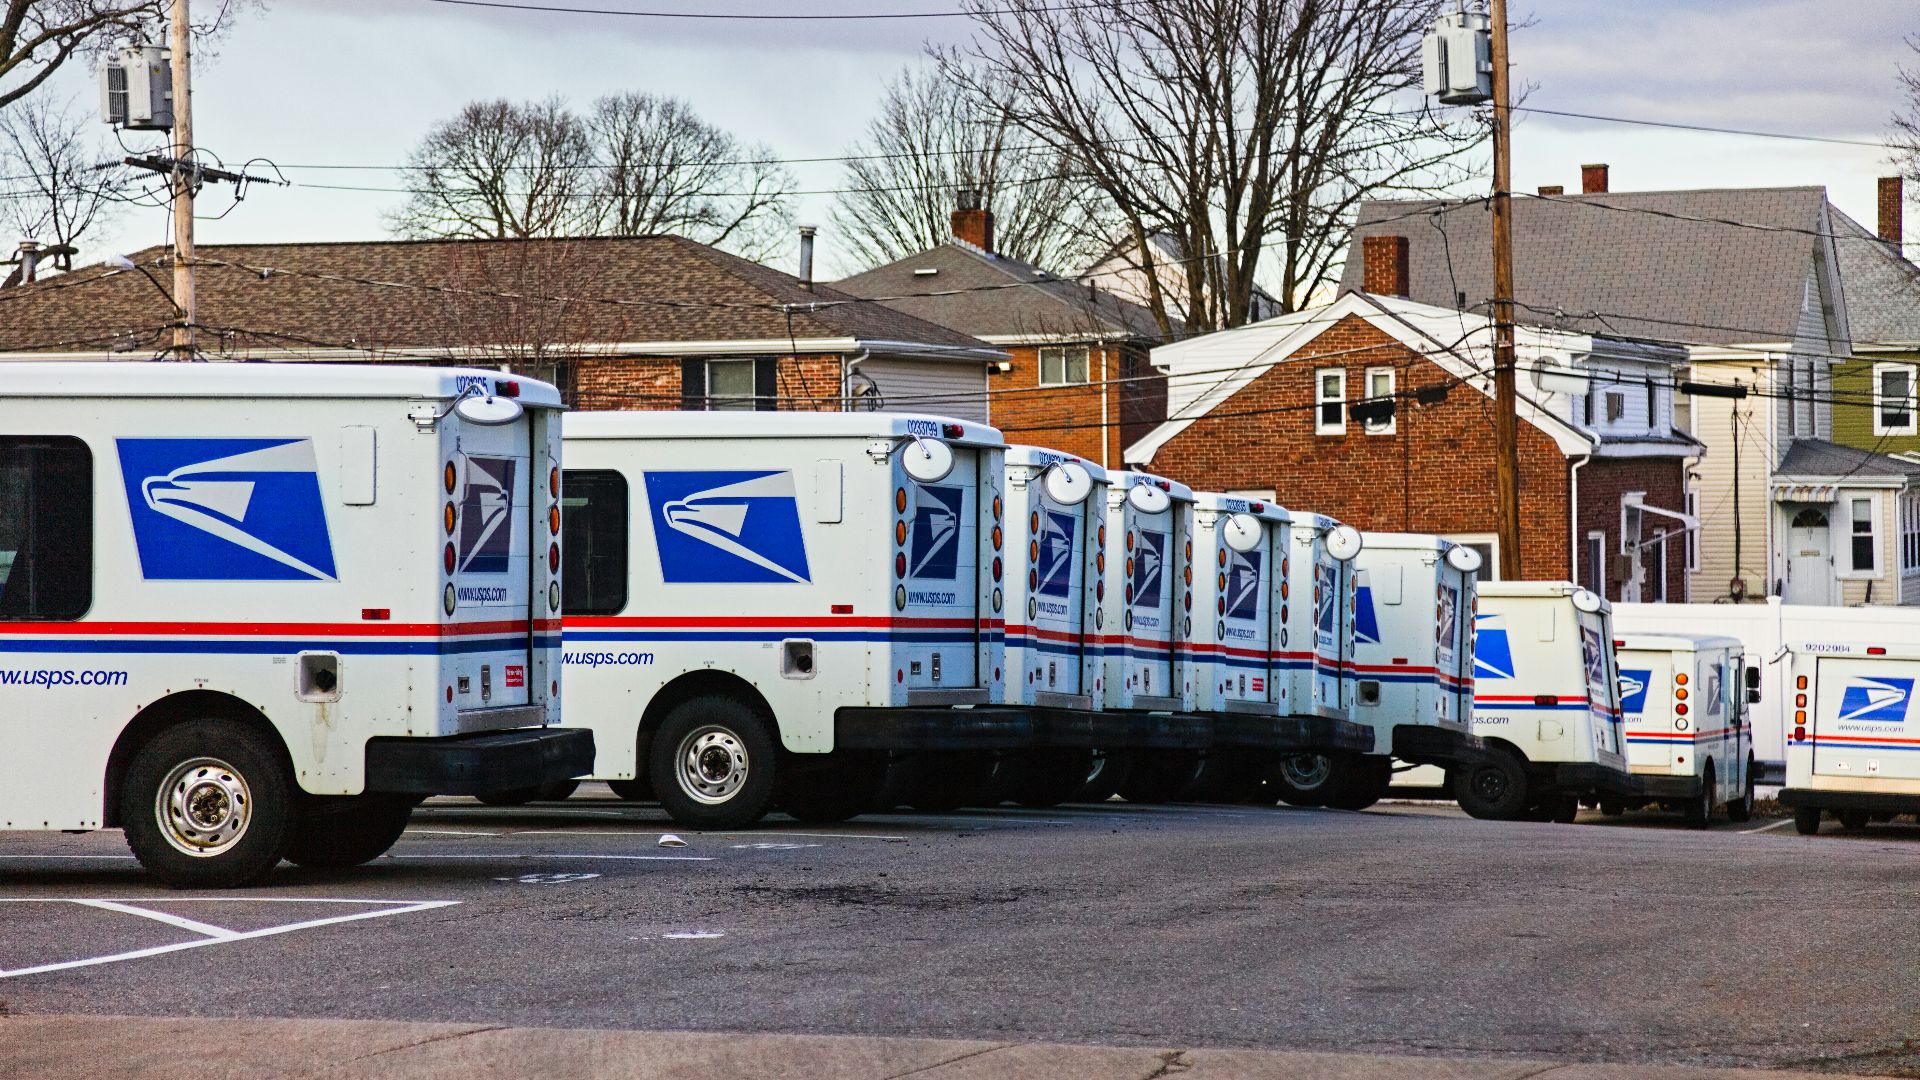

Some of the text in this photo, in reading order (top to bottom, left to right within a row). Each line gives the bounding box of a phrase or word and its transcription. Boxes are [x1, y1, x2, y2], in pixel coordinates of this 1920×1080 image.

[907, 419, 938, 437] 0233799
[458, 587, 507, 605] www.usps.com
[908, 591, 956, 607] www.usps.com
[1838, 724, 1904, 733] www.usps.com
